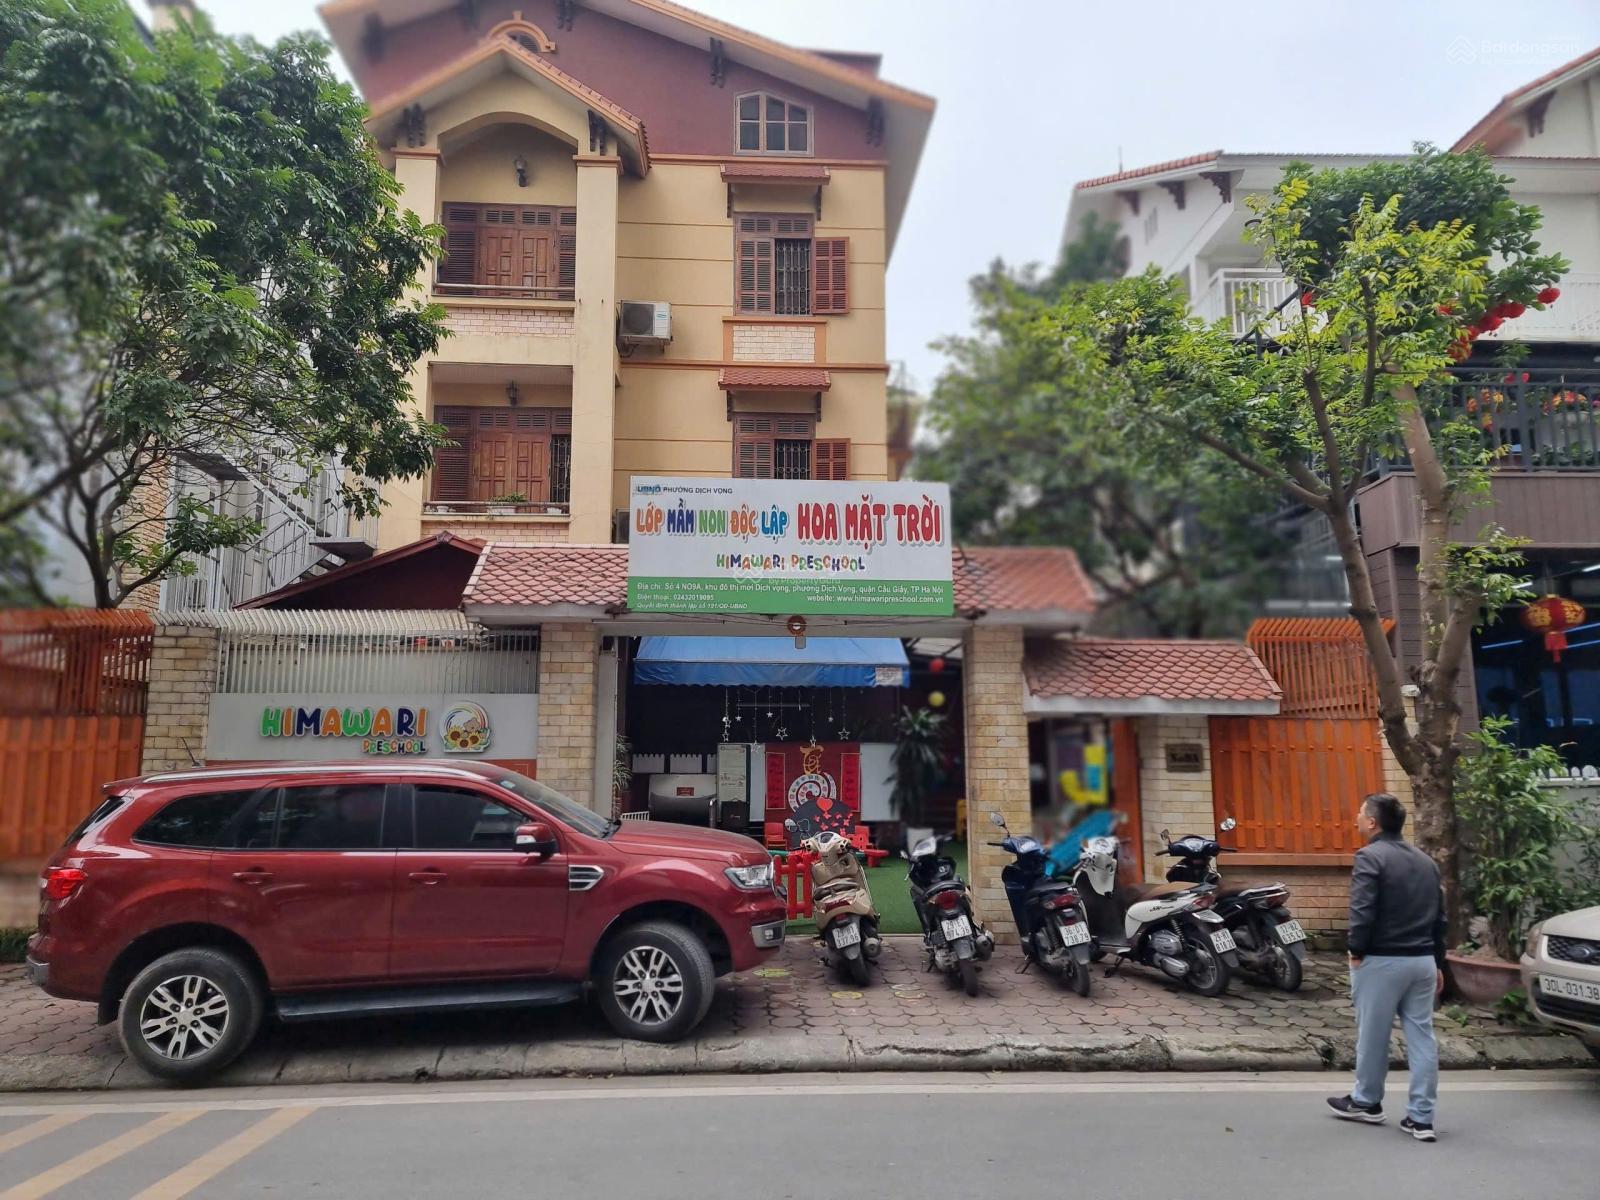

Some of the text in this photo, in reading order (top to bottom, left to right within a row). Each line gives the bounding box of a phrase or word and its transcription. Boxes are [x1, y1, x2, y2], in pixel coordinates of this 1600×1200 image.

[695, 487, 712, 495] DỊCH
[636, 494, 941, 550] LỚP MẦM NON ĐỘC LẬP HOA MẶT TRỜI
[716, 554, 866, 573] HIMAWARI PRESCHOOL
[755, 584, 771, 594] Dịch
[792, 585, 820, 595] phường
[821, 585, 837, 595] Dịch
[860, 585, 876, 596] quận
[260, 706, 428, 737] HIMAWARI
[362, 739, 427, 754] PRESCHOOL
